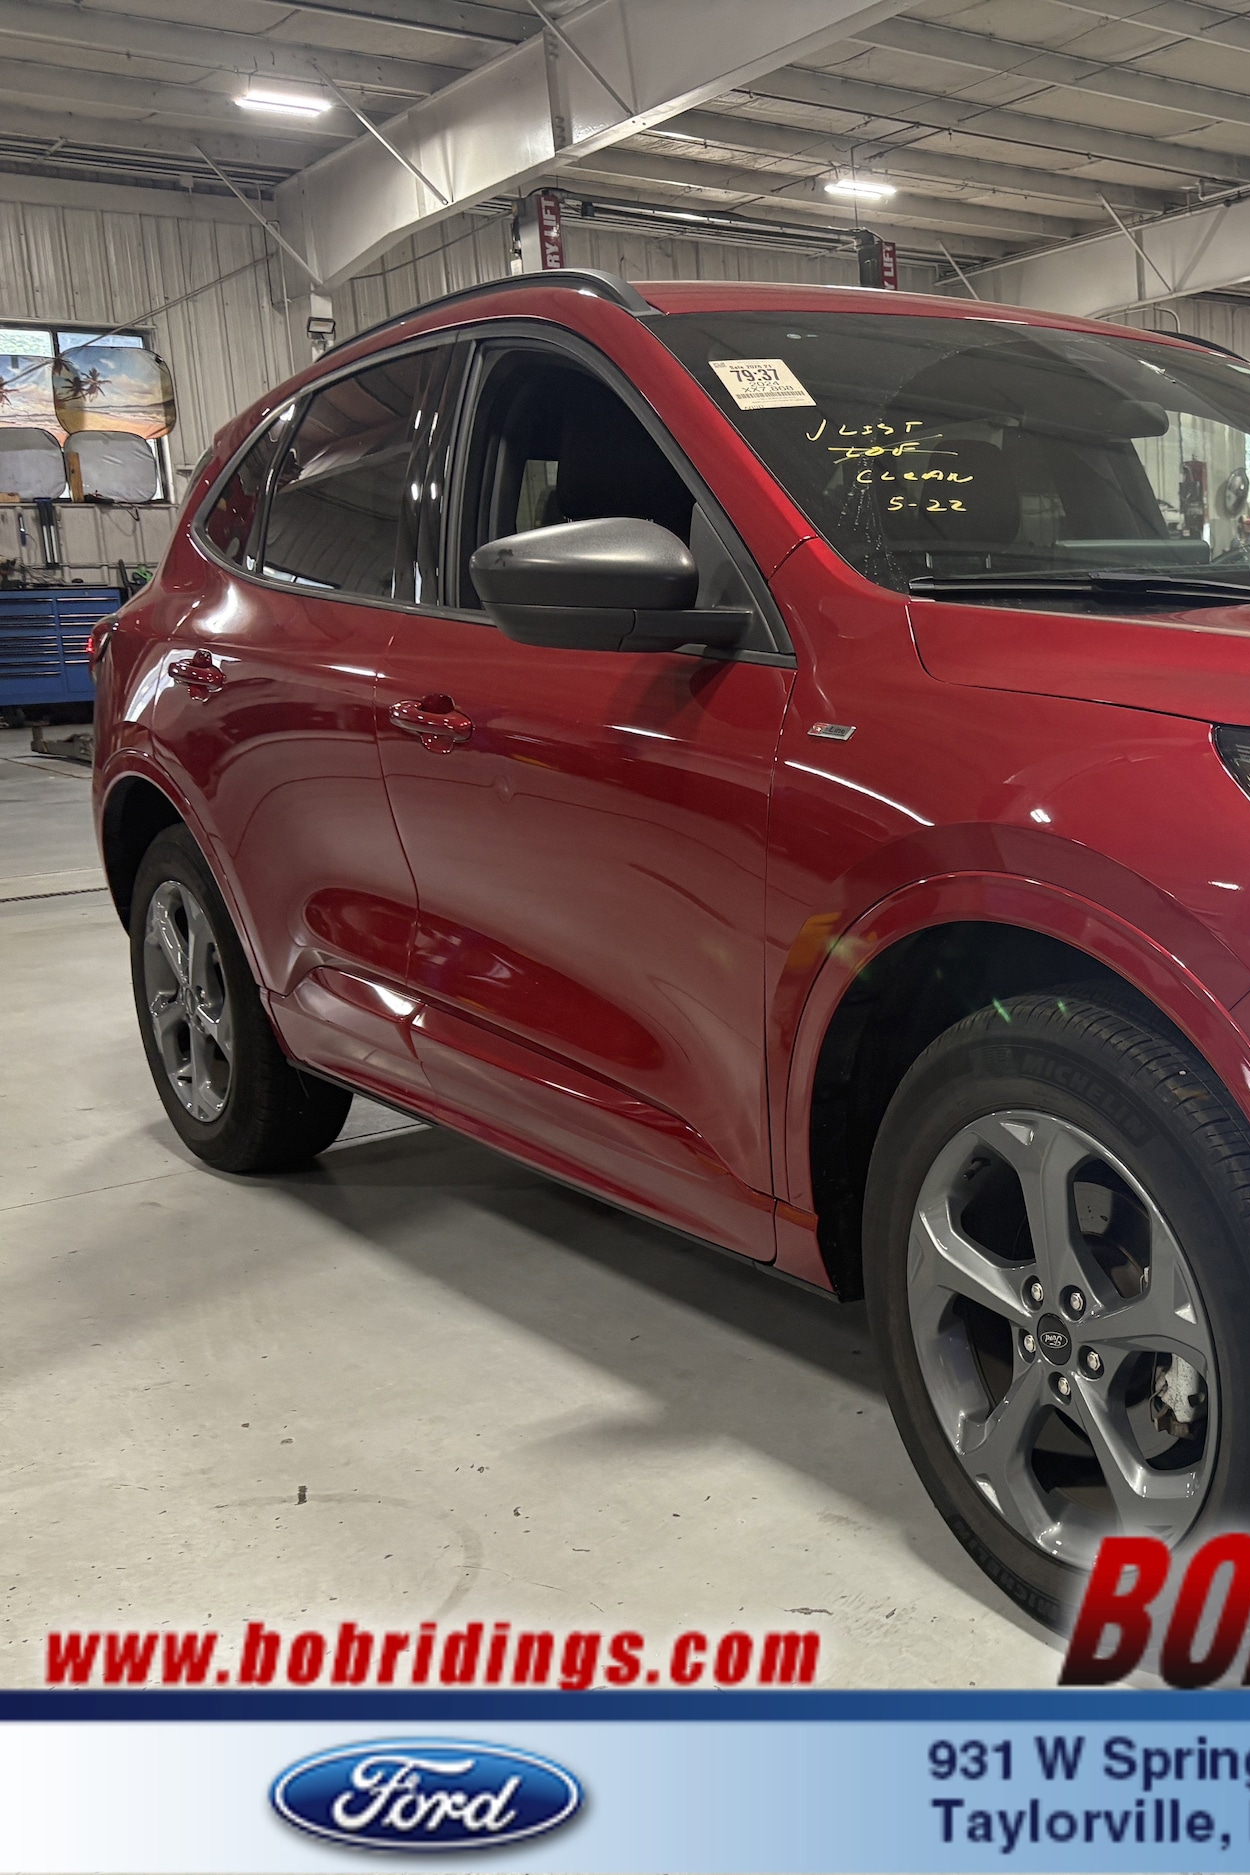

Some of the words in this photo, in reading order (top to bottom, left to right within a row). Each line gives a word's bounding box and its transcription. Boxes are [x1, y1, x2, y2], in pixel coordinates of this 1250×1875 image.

[541, 197, 559, 237] LIFT
[882, 242, 895, 277] LIFT
[729, 368, 780, 382] 79:37
[838, 421, 923, 436] LIST
[887, 496, 967, 512] 5-22
[1020, 1053, 1145, 1139] MICHELIN
